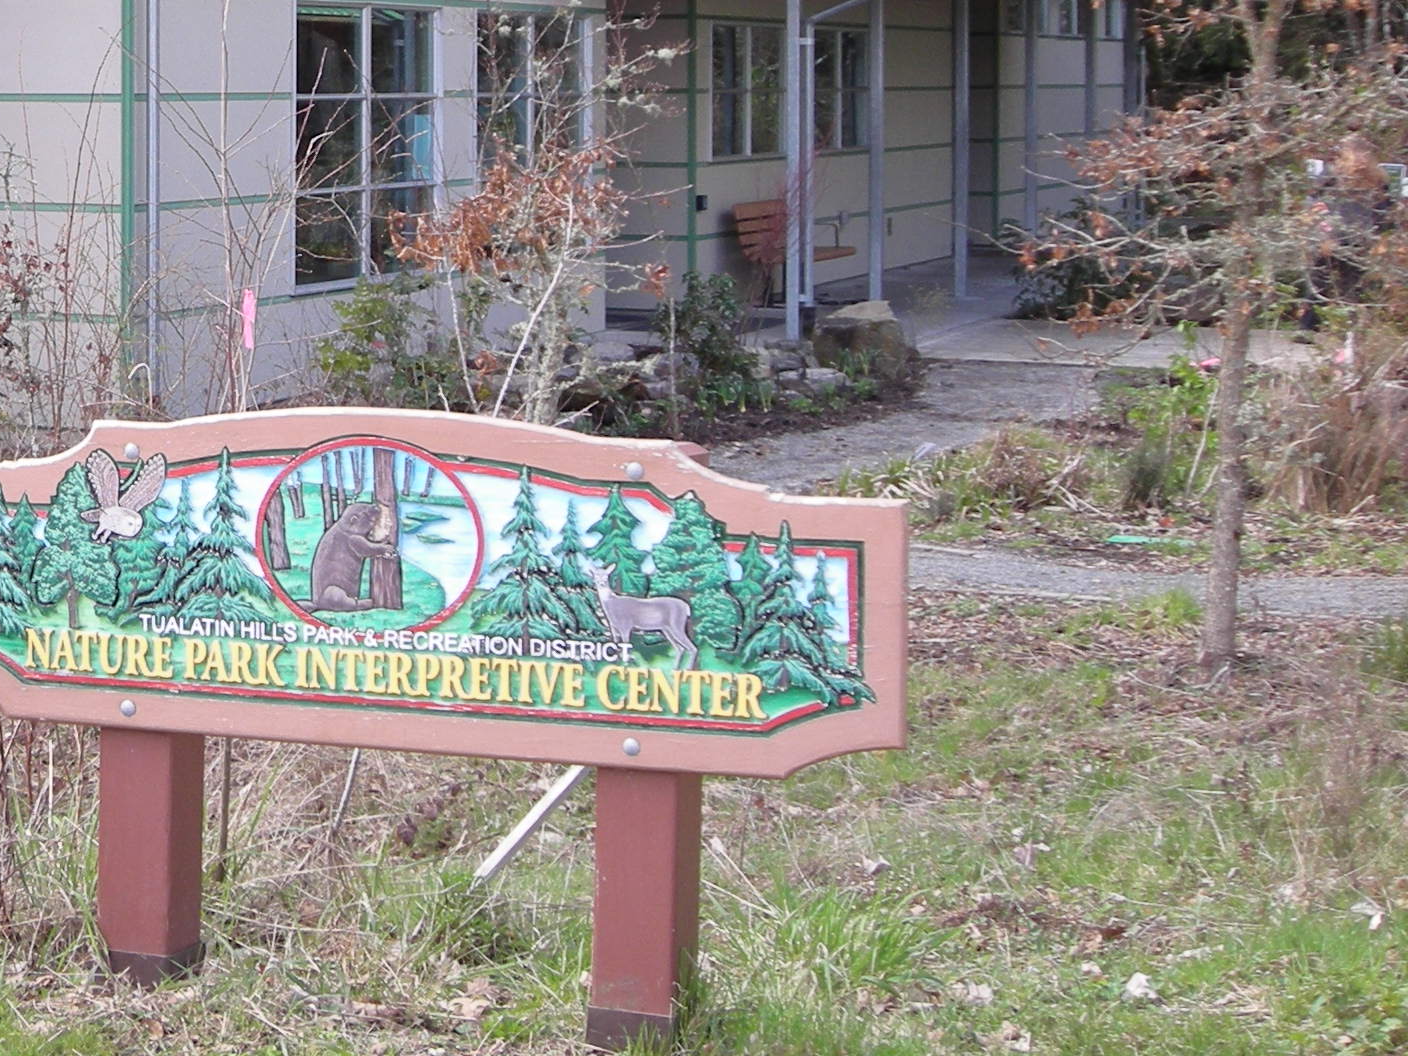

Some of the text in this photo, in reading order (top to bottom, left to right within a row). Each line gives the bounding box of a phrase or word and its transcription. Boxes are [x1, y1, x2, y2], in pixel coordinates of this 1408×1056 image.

[139, 614, 235, 638] TUALATIN
[304, 627, 357, 646] PARK
[363, 631, 378, 647] &
[383, 630, 524, 656] RECREATION
[530, 638, 633, 662] DISTRICT
[25, 627, 768, 720] NATURE PARK INTERPRETIVE CENTER
